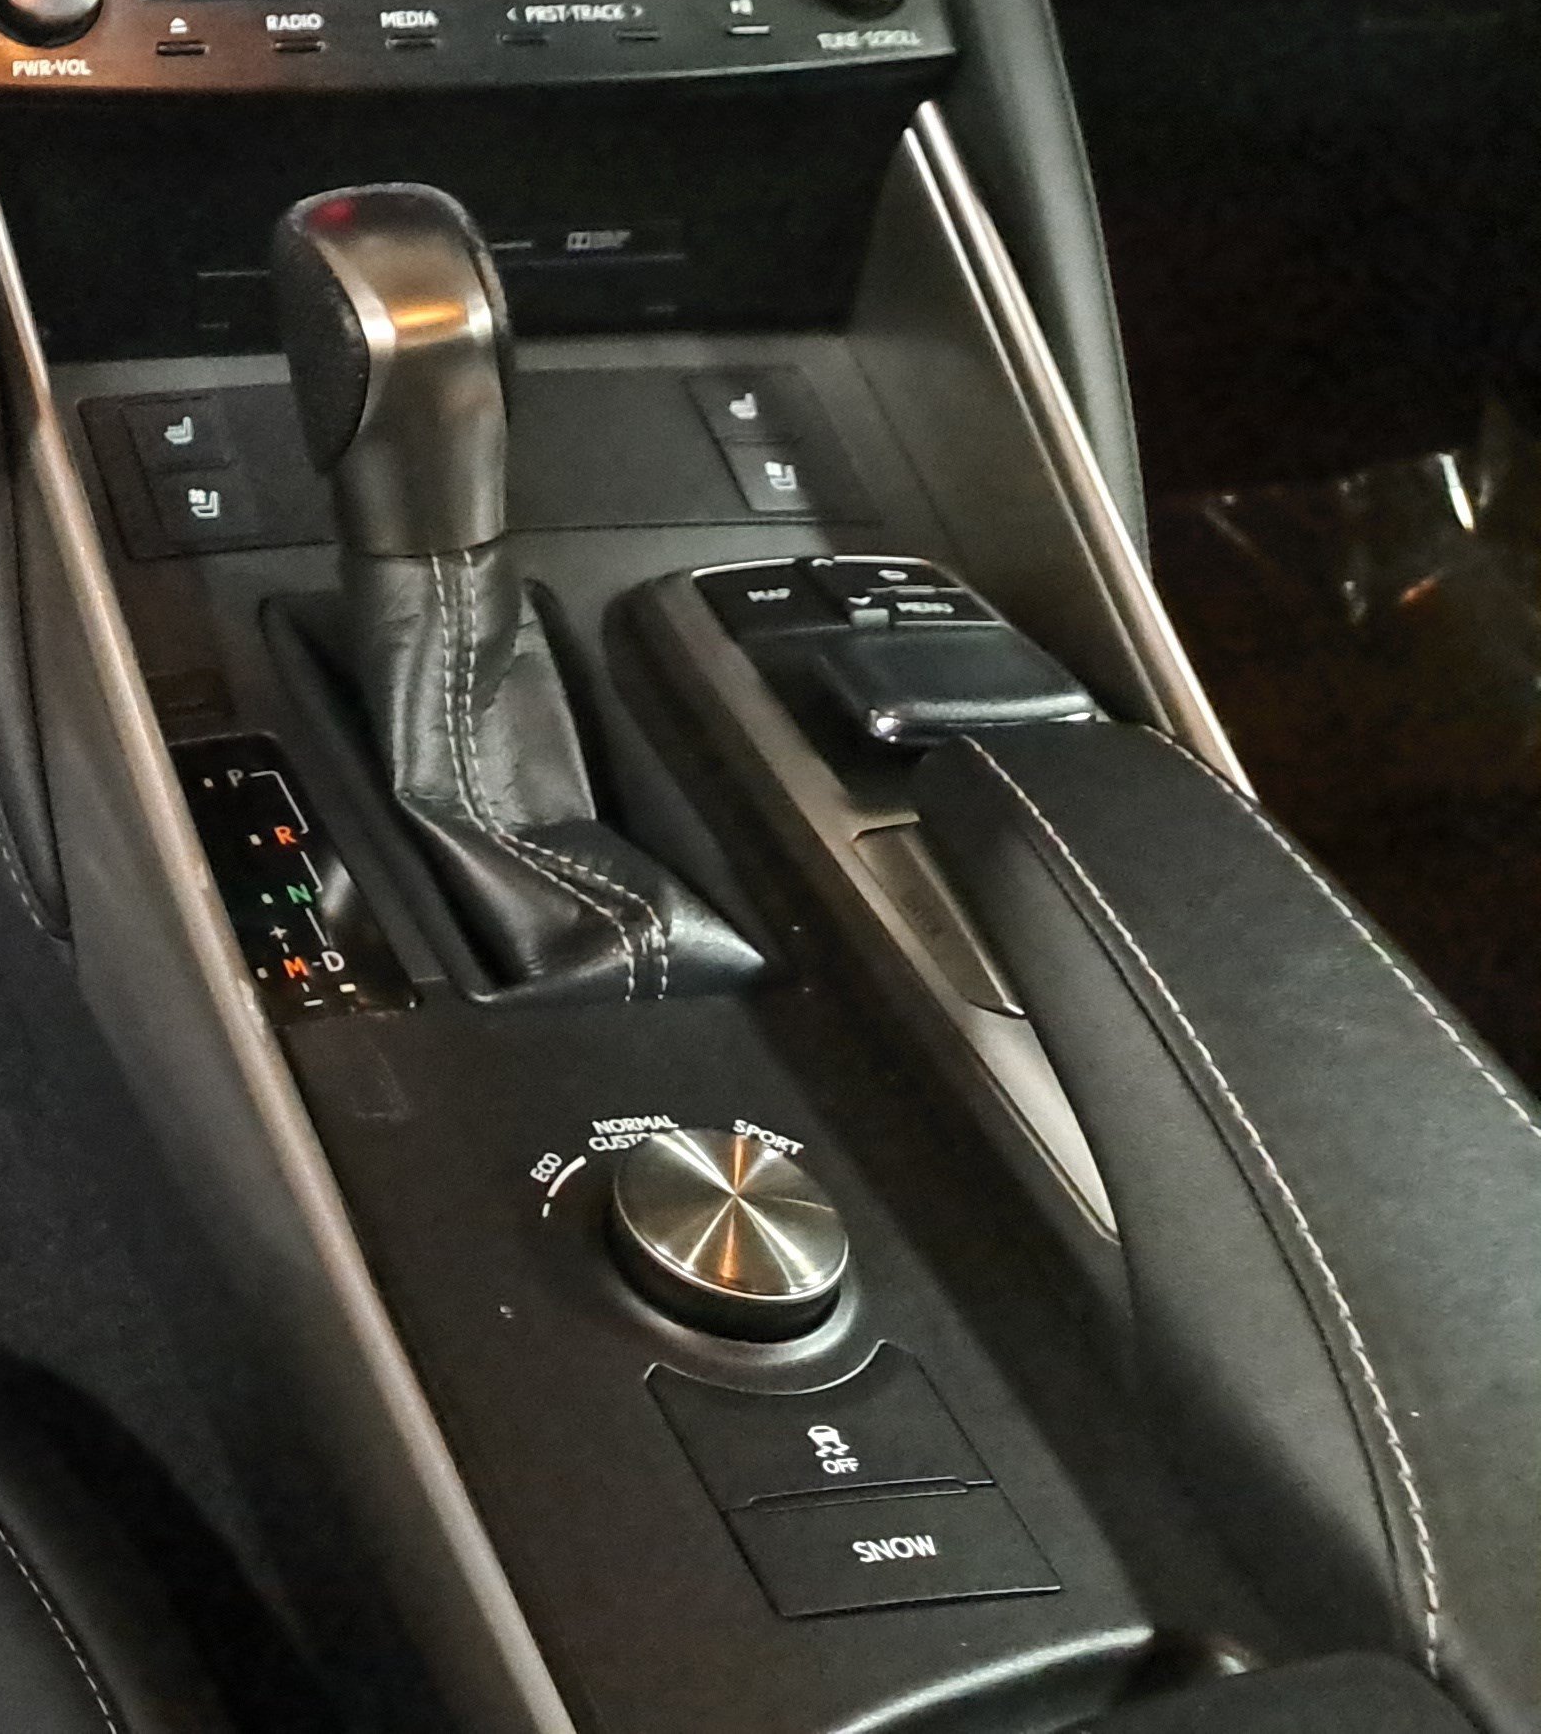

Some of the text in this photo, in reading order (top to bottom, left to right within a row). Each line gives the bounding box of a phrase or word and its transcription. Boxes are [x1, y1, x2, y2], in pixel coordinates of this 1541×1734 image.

[265, 13, 325, 32] RADIO
[380, 9, 439, 30] MEDIA
[226, 768, 245, 787] P
[273, 825, 297, 845] R
[286, 883, 313, 903] N
[282, 950, 346, 979] M D
[592, 1114, 679, 1135] NORMAL
[732, 1119, 805, 1157] SPORT
[529, 1152, 563, 1185] ECO
[821, 1456, 860, 1475] OFF
[852, 1534, 937, 1563] SNOW
